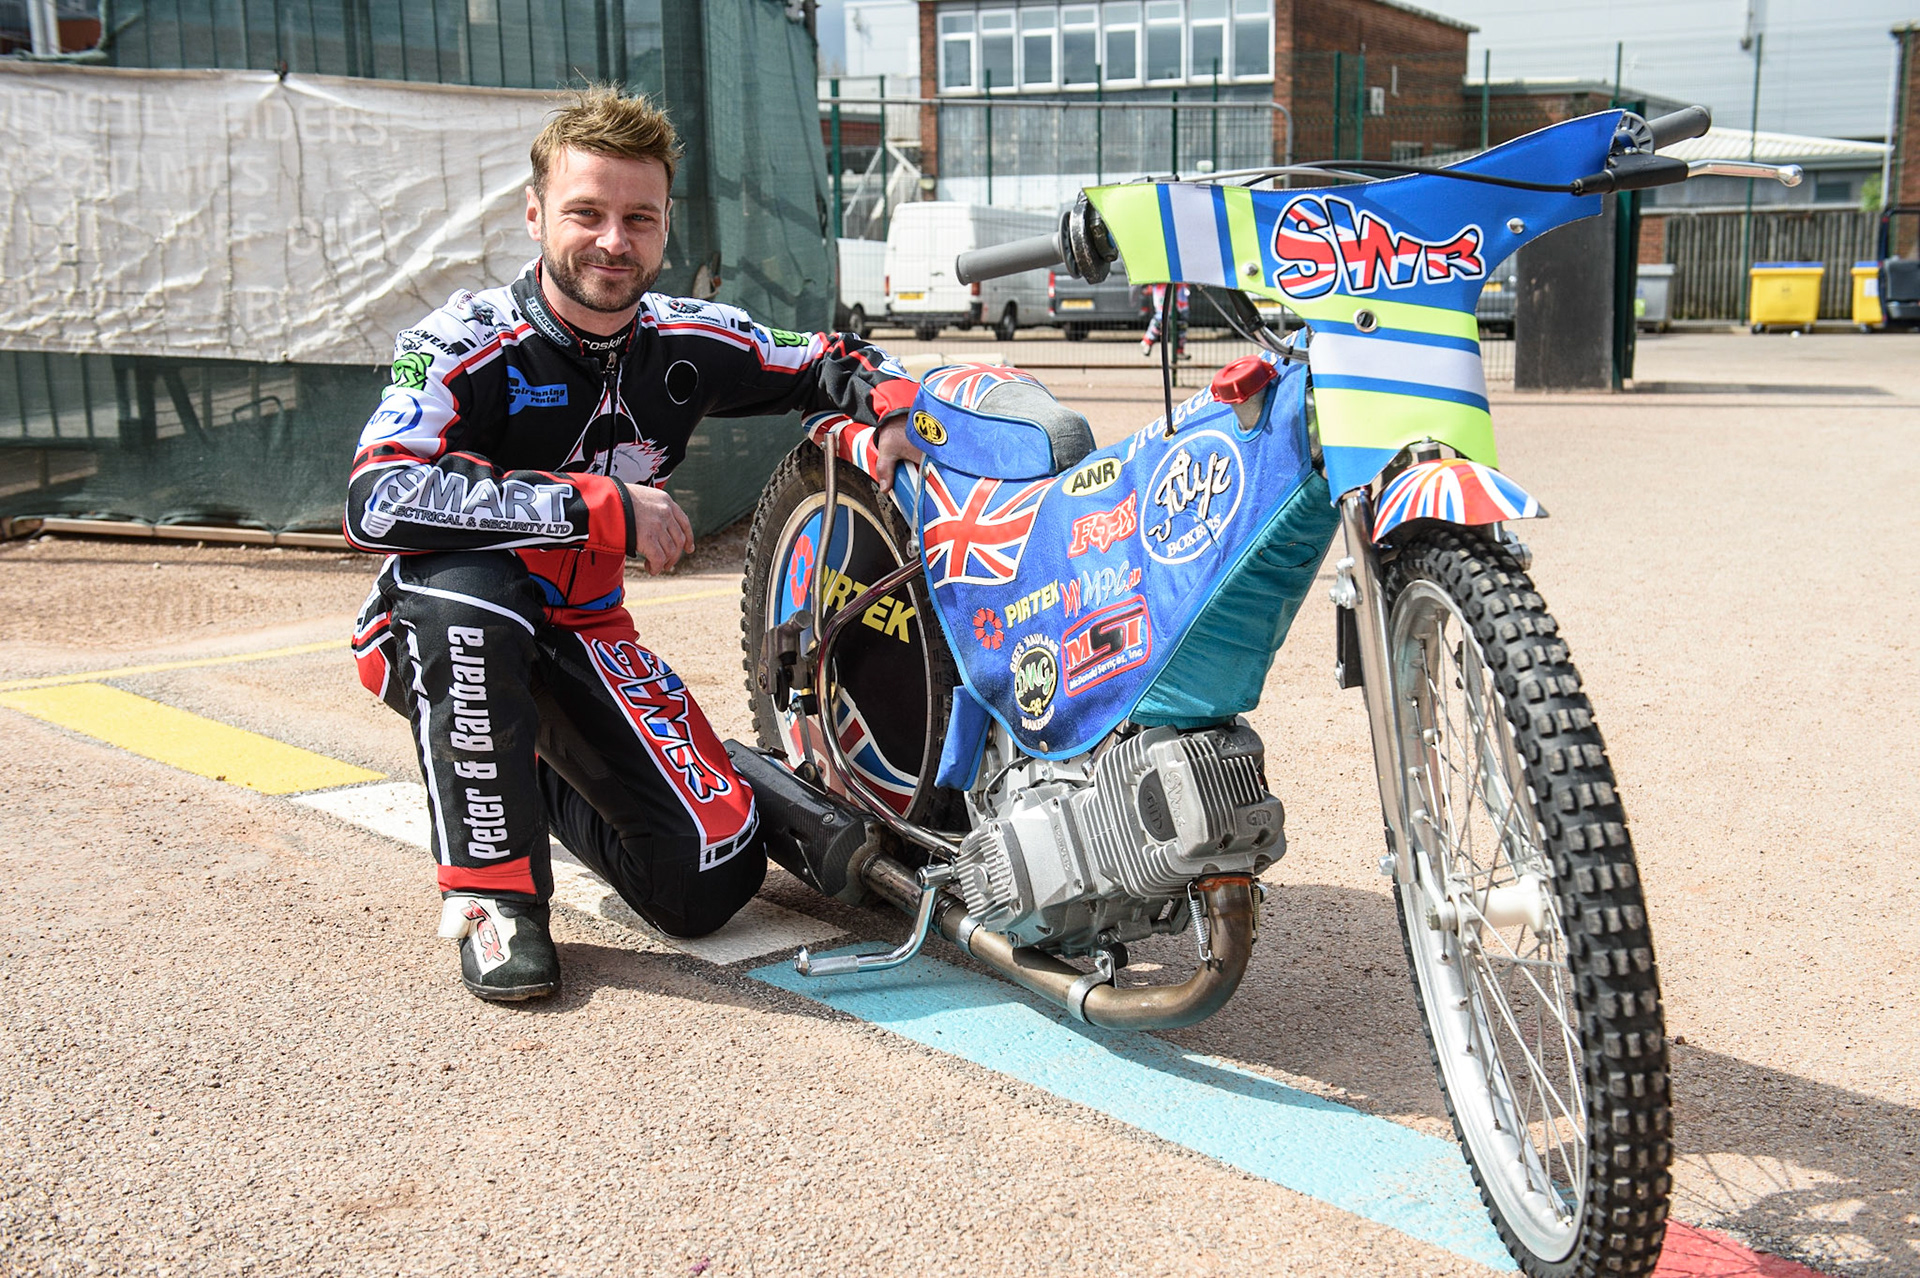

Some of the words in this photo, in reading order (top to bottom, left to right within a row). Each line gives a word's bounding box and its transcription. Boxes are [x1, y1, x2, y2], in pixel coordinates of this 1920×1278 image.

[1272, 194, 1486, 300] SWR
[387, 465, 570, 523] SMART
[1071, 460, 1116, 494] ANR
[378, 499, 464, 527] ELECTRICAL
[465, 516, 477, 528] &
[479, 518, 548, 534] SECURITY
[546, 524, 571, 535] LTD
[1068, 489, 1138, 559] FOX
[1004, 579, 1061, 628] PIRTEK
[1064, 608, 1144, 675] MSI
[447, 624, 497, 753] Barbara
[454, 760, 498, 785] &
[468, 787, 511, 861] Peter
[459, 899, 506, 963] TCX
